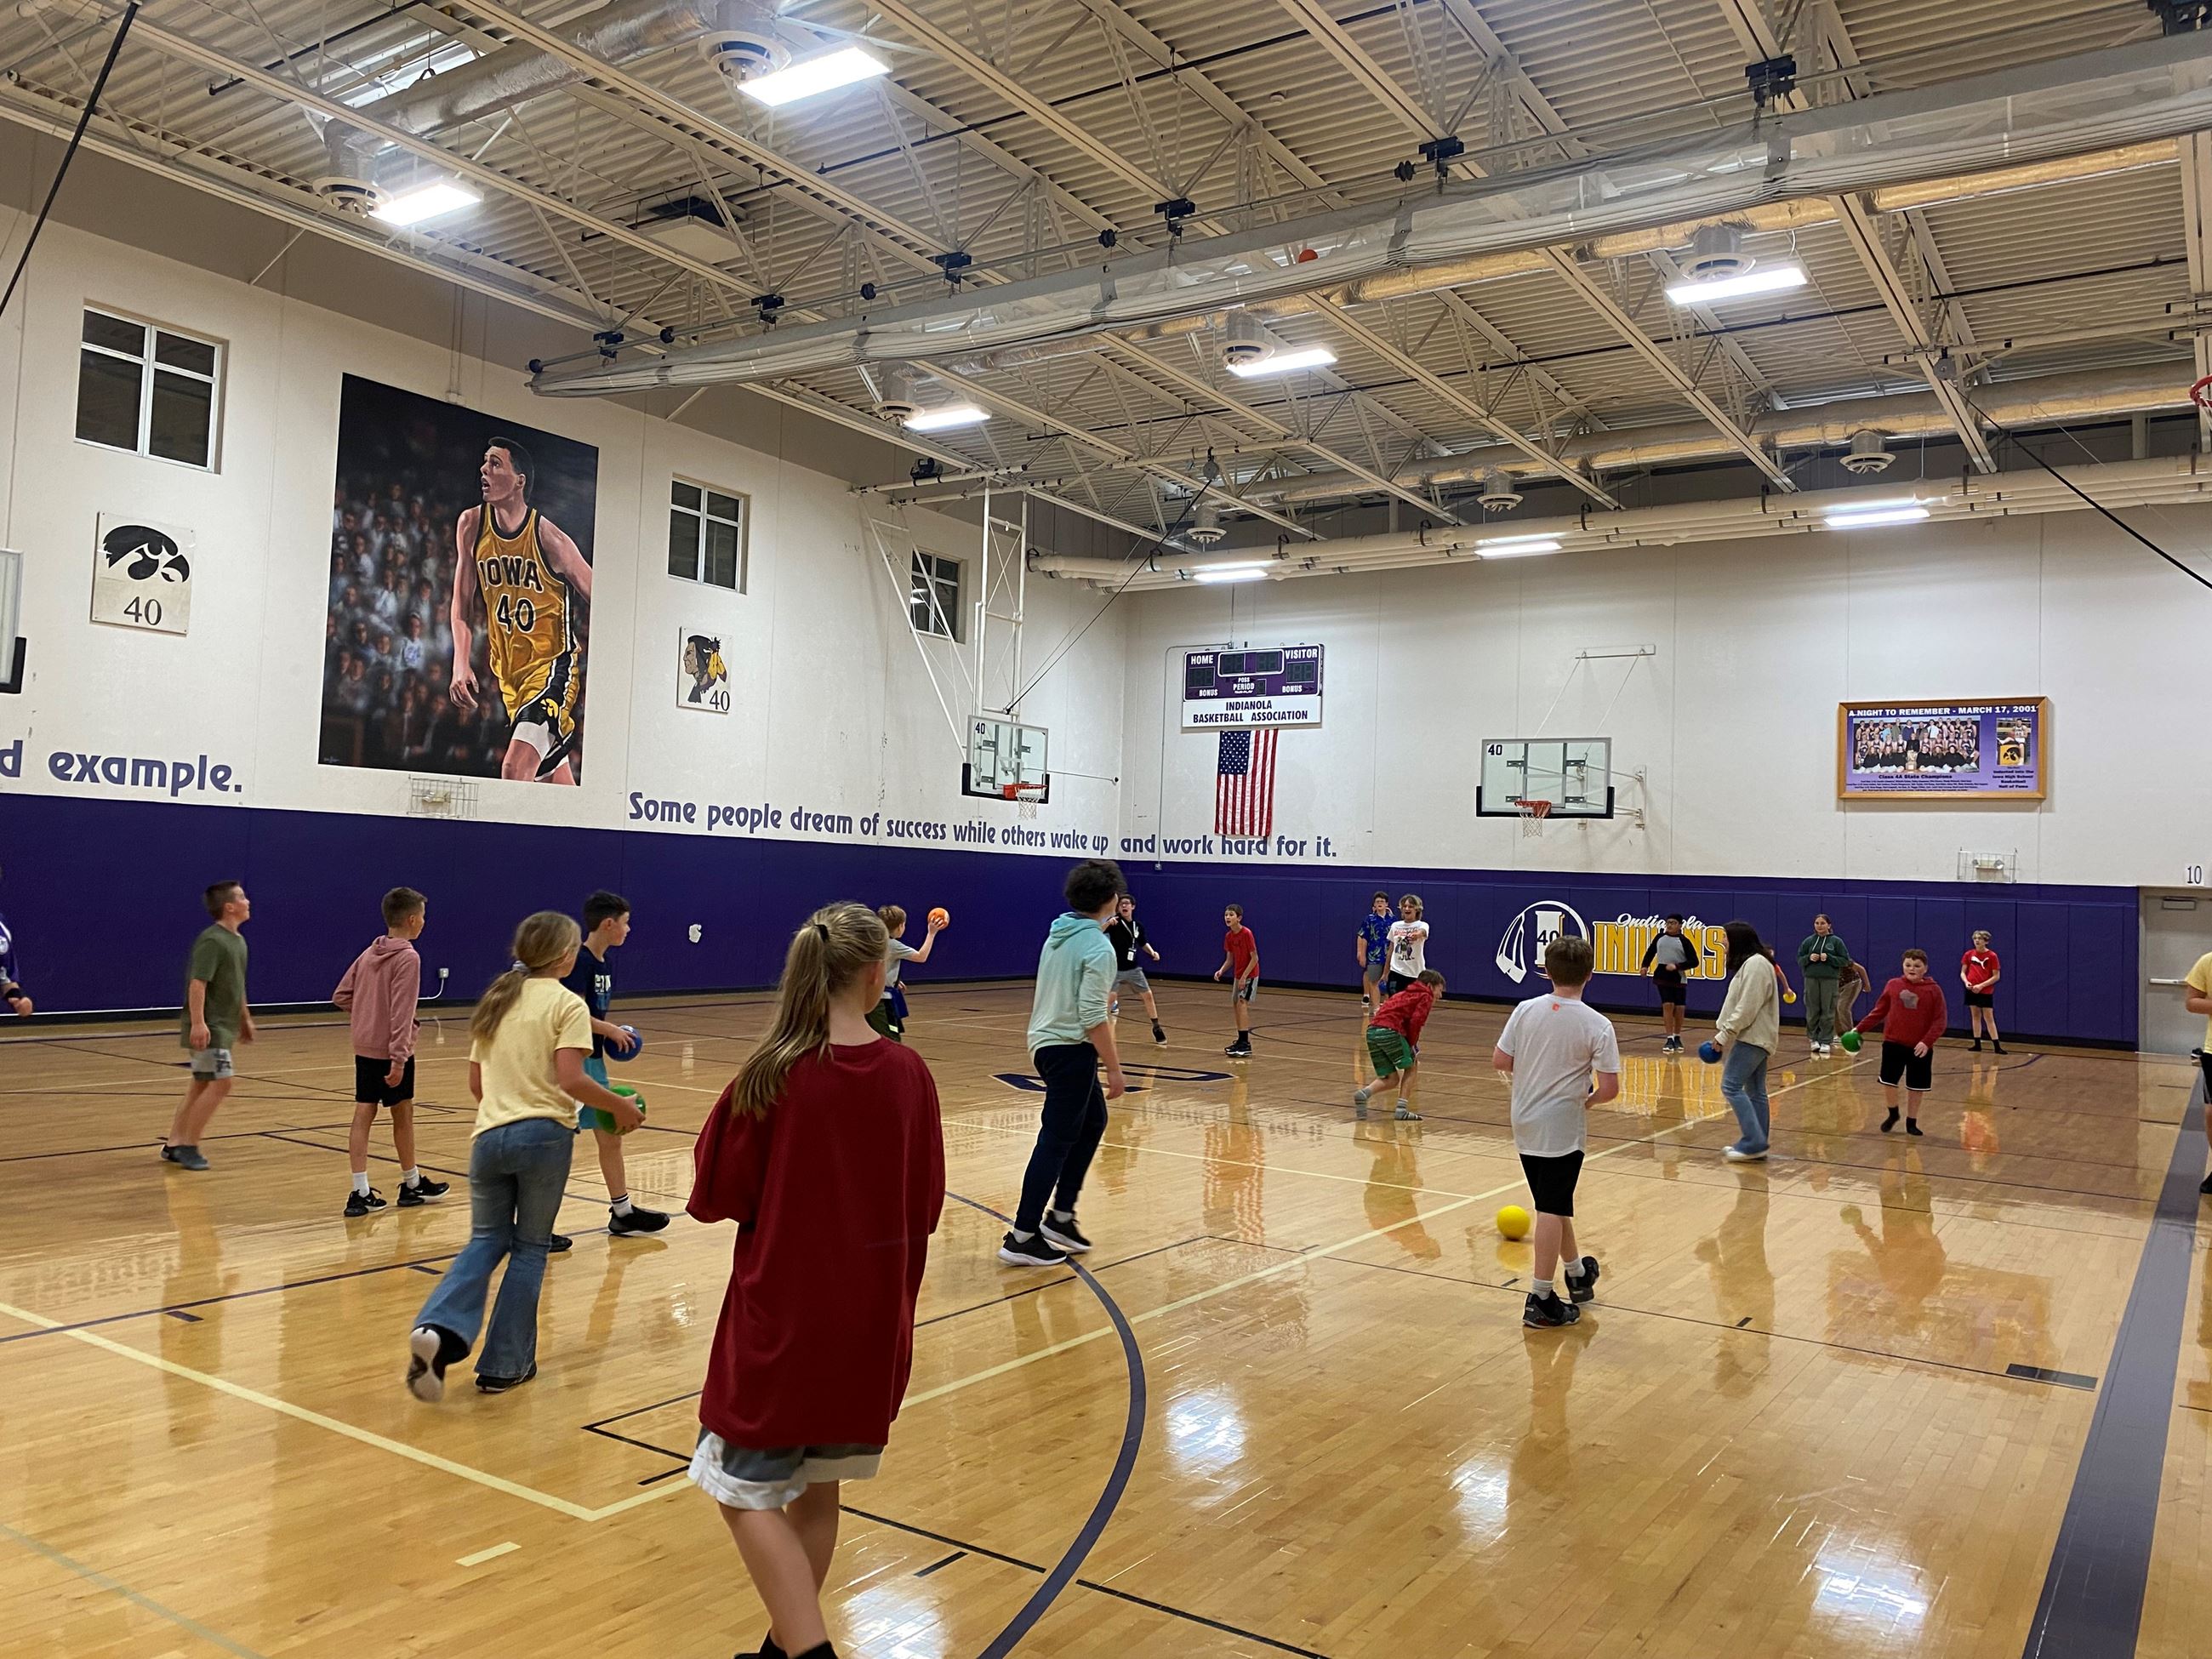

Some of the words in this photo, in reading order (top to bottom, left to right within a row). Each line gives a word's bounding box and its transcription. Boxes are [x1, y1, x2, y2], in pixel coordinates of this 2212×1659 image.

[478, 555, 544, 593] IOWA
[123, 596, 162, 626] 40
[496, 594, 536, 633] 40
[1191, 655, 1214, 664] HOME
[1285, 648, 1318, 659] VISITOR
[710, 690, 730, 711] 40
[1226, 700, 1272, 711] INDIANOLA
[1193, 713, 1244, 723] BASKETBALL
[1251, 710, 1308, 721] ASSOCIATION
[975, 722, 985, 735] 40
[1487, 744, 1502, 755] 40
[48, 751, 242, 797] example.
[629, 792, 697, 824] Some
[708, 803, 782, 834] people
[790, 806, 852, 834] dream
[860, 812, 880, 835] of
[887, 818, 946, 841] success
[953, 821, 995, 843] while
[1001, 825, 1046, 847] others
[1050, 830, 1087, 850] wake
[1092, 835, 1109, 855] up
[1120, 834, 1155, 853] and
[1162, 835, 1213, 854] work
[1221, 835, 1268, 856] hard
[1276, 835, 1308, 856] for
[1316, 836, 1337, 857] it.
[2186, 865, 2202, 885] 10
